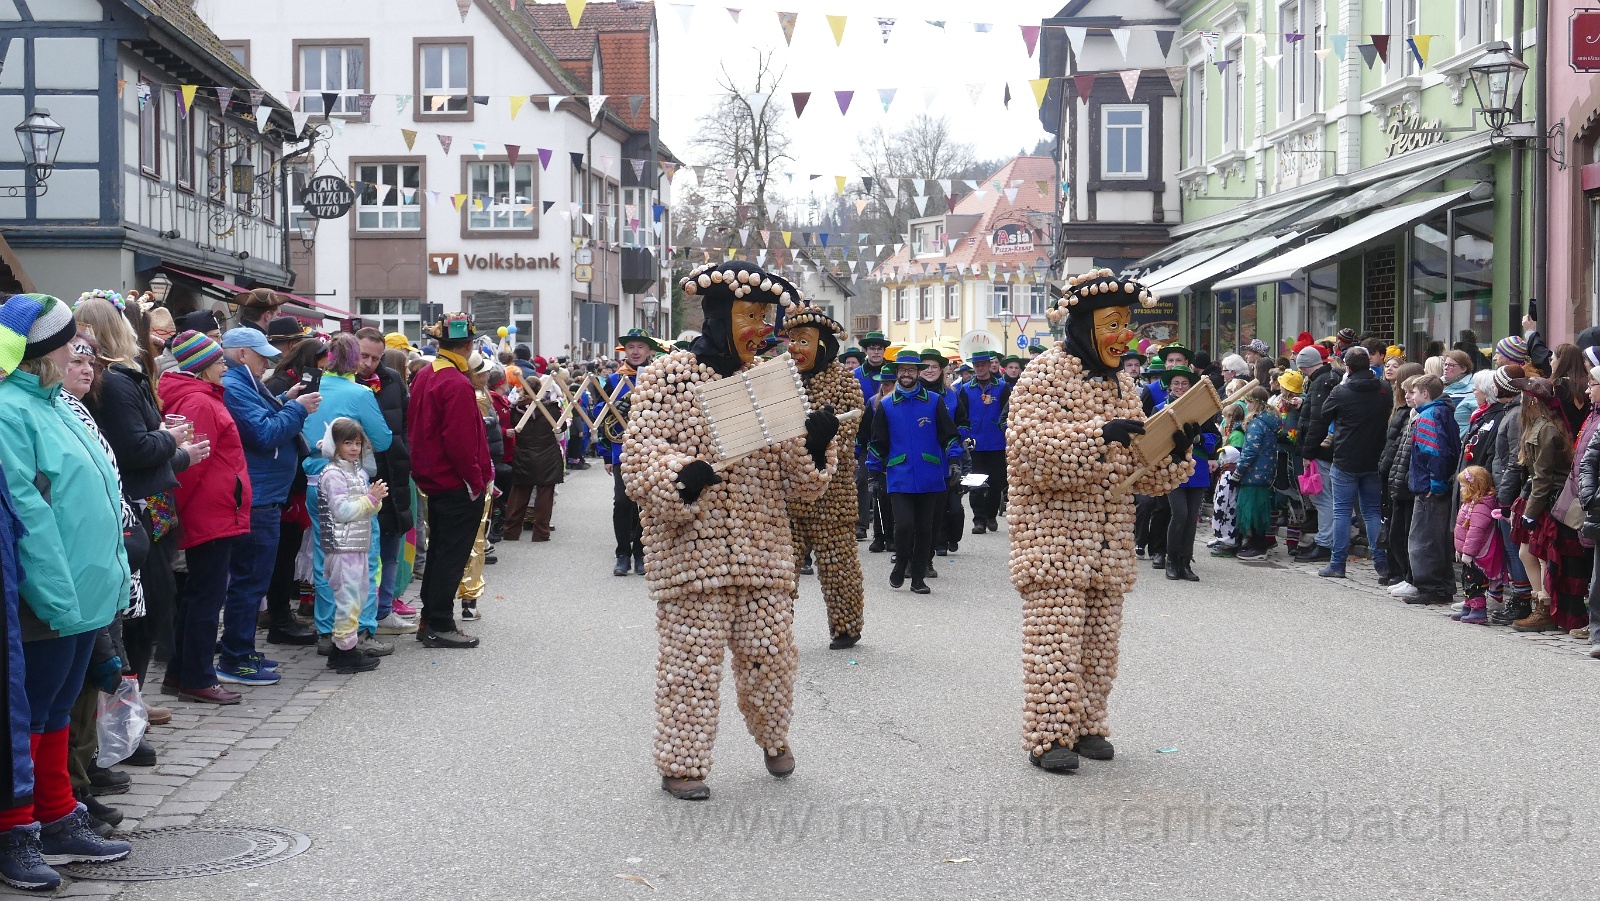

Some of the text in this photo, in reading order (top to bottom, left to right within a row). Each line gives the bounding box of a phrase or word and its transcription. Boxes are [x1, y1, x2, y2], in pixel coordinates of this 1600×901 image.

[303, 191, 352, 206] ALTZELL
[316, 205, 340, 217] 1779
[997, 229, 1030, 246] Asia
[464, 252, 561, 271] Volksbank
